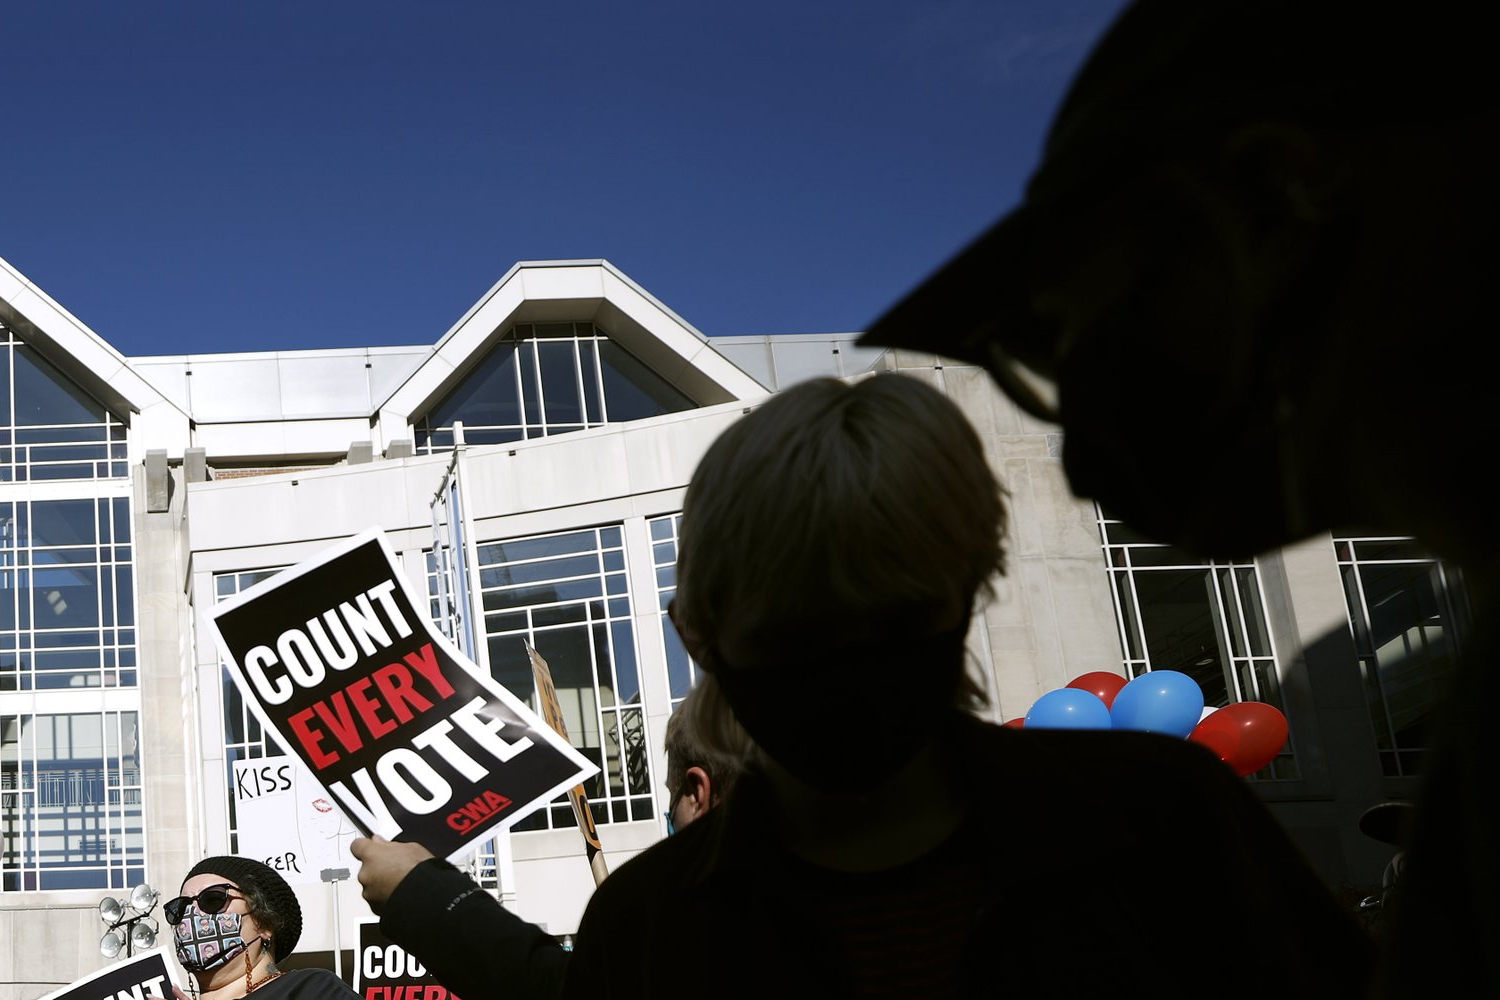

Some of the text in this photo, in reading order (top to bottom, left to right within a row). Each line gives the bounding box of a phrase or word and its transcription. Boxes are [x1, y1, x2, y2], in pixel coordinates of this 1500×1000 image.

[244, 578, 413, 705] COUNT
[287, 643, 456, 770] EVERY
[235, 765, 292, 800] KISS
[329, 696, 534, 840] VOTE
[446, 790, 512, 836] CWA
[363, 945, 428, 979] COU
